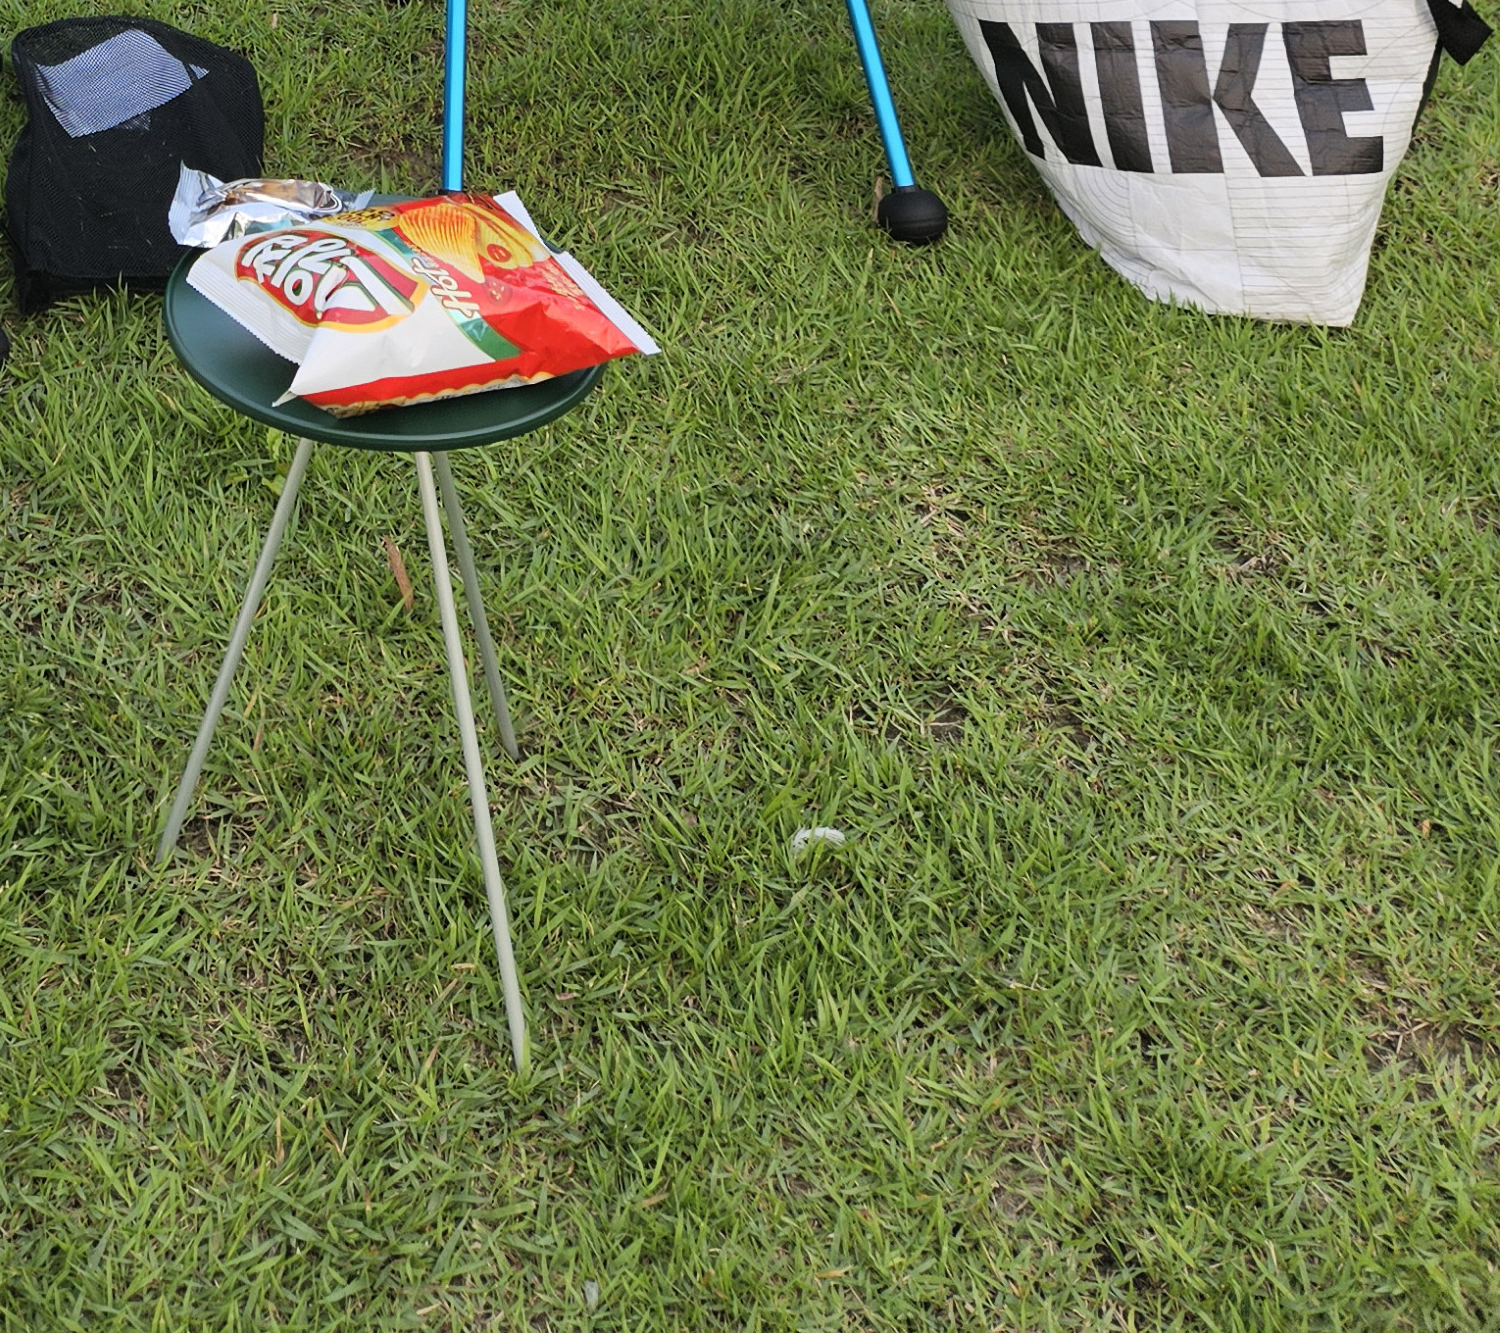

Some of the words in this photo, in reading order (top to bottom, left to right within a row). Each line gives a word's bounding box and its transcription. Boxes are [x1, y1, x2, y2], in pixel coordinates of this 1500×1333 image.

[979, 19, 1385, 177] NIKE
[242, 235, 415, 320] 스윙칩
[411, 256, 482, 319] Hot
